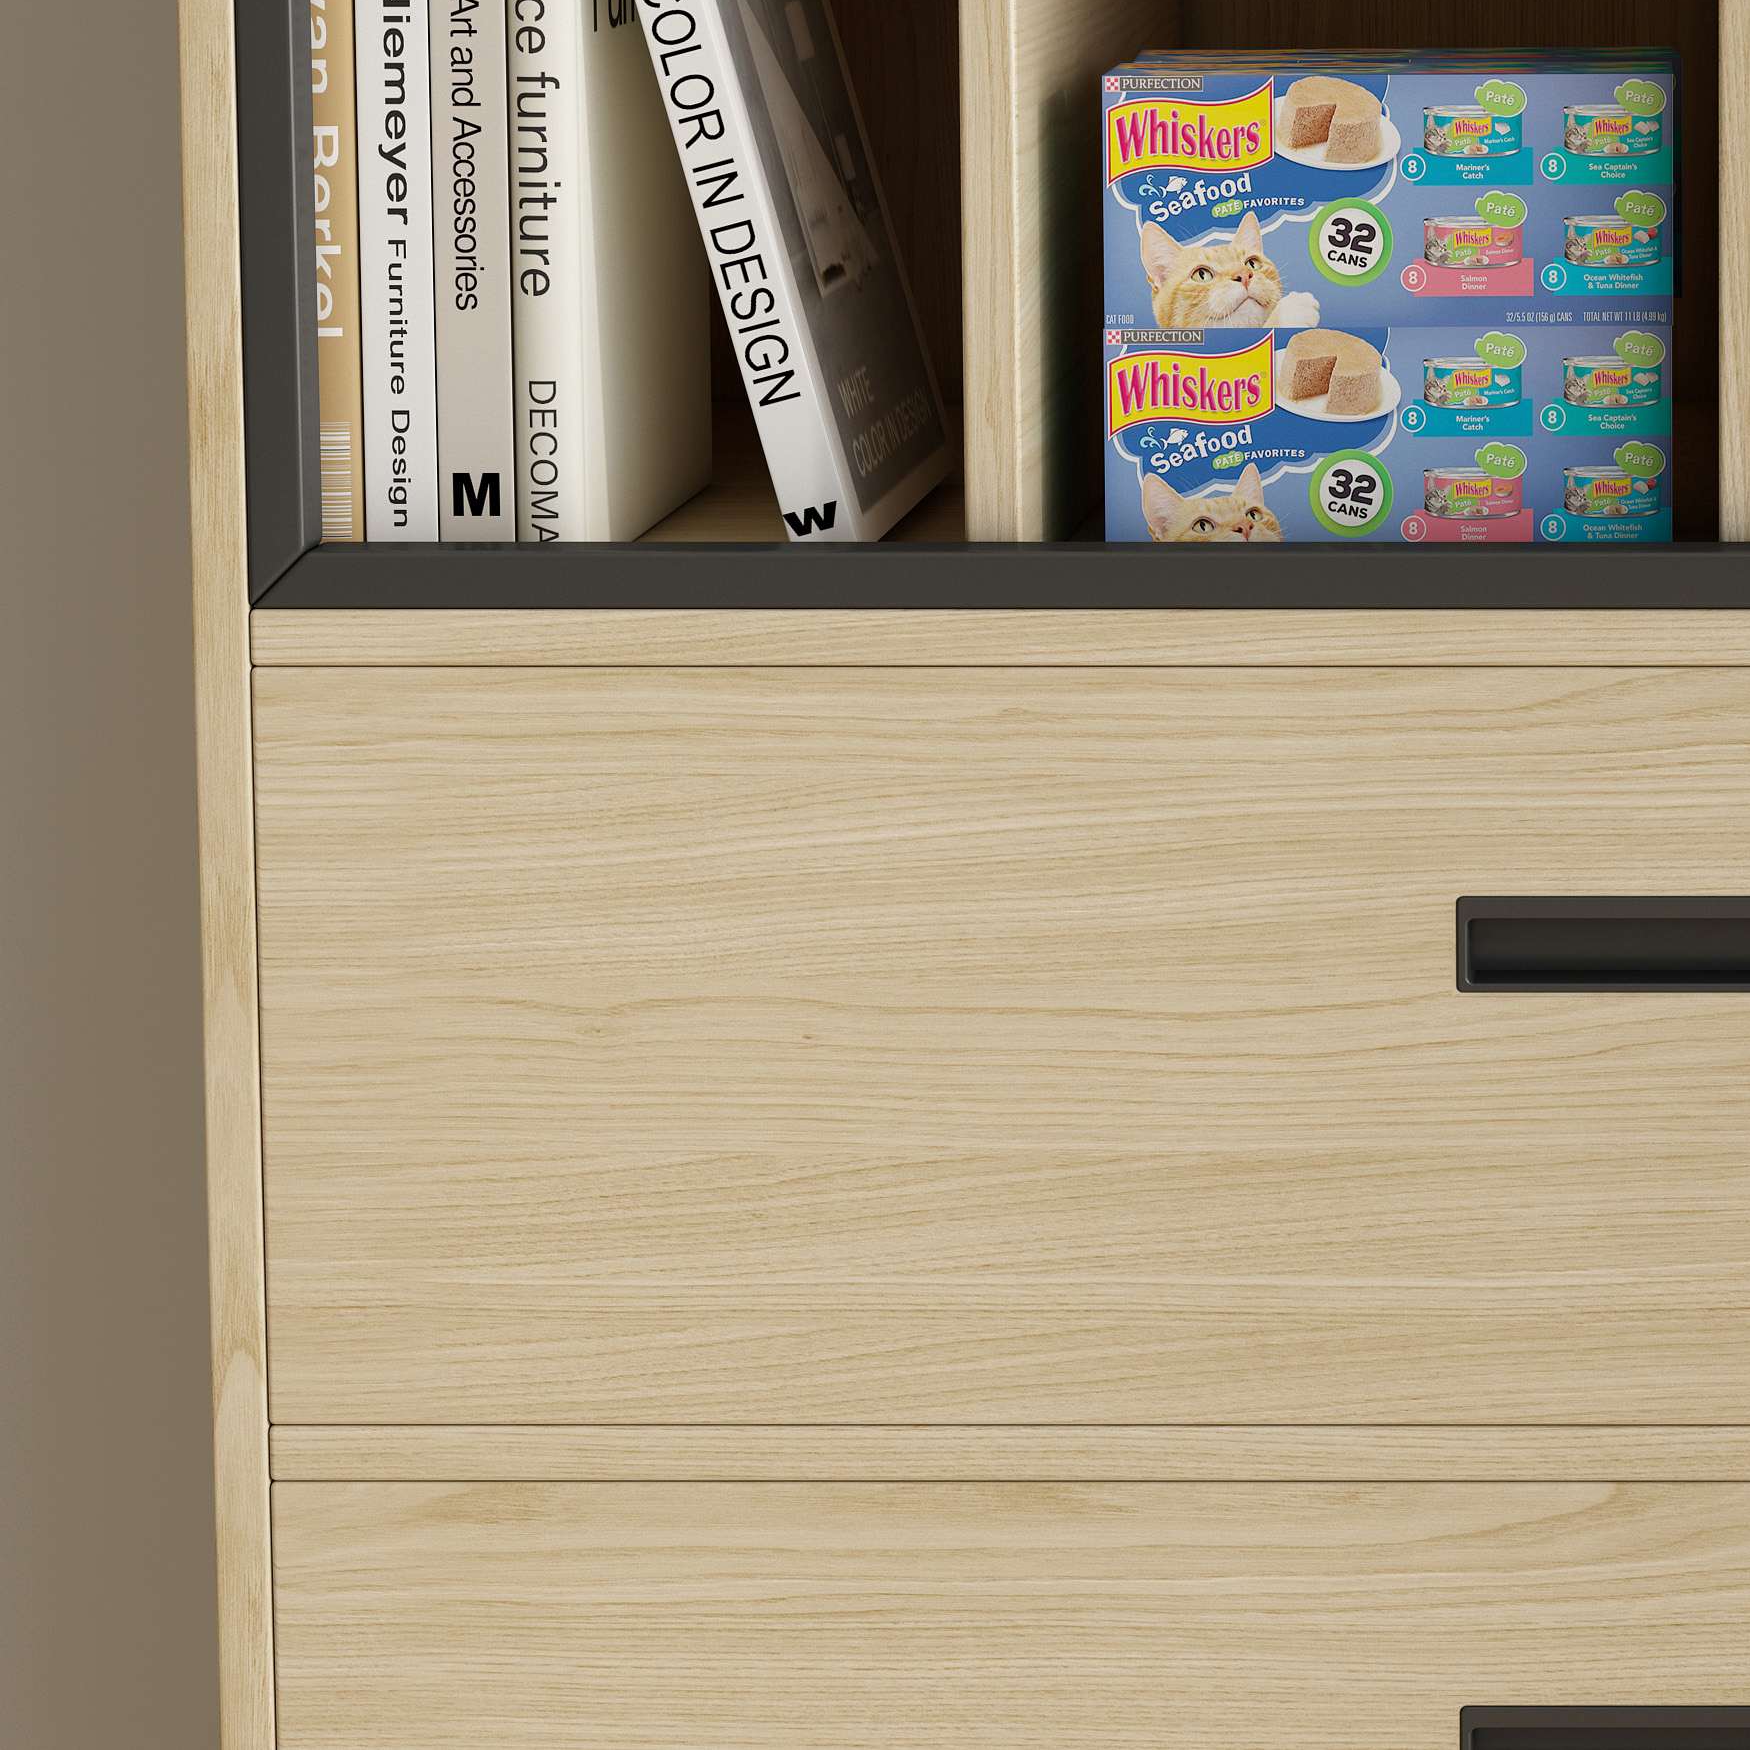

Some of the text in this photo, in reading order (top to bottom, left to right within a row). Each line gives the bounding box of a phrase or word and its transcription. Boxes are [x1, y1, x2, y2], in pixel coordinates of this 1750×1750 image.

[450, 46, 482, 107] and
[1122, 77, 1201, 90] PURFECTION
[1455, 118, 1489, 135] Whiskers
[1595, 118, 1629, 135] Whiskers
[1116, 109, 1261, 163] Whiskers
[1408, 160, 1417, 172] 8
[1455, 163, 1490, 172] Mariner's
[1549, 159, 1557, 172] 8
[1589, 163, 1637, 172] Sea Captain's
[1462, 172, 1484, 180] Catch
[1600, 171, 1625, 179] Choice
[516, 71, 562, 297] furniture
[692, 158, 744, 209] IN
[1149, 173, 1252, 222] Seafood
[1243, 197, 1305, 209] FAVORITES
[452, 117, 485, 311] Accessories
[1327, 218, 1376, 254] 32
[1455, 230, 1489, 246] Whiskers
[1595, 229, 1629, 246] Whiskers
[1327, 250, 1368, 268] CANS
[1409, 271, 1417, 283] 8
[1460, 274, 1487, 282] Salmon
[1549, 271, 1557, 283] 8
[1608, 273, 1643, 282] Whitefish
[1462, 282, 1486, 290] Dinner
[1614, 282, 1639, 290] Dinner
[387, 239, 409, 395] Furniture
[710, 219, 801, 407] DESIGN
[1106, 315, 1134, 324] CAT FOOD
[1556, 312, 1573, 322] CANS
[1584, 312, 1600, 322] TOTAL
[1602, 312, 1613, 321] NET
[1614, 312, 1623, 321] WT
[1123, 331, 1202, 343] PURFECTION
[1455, 370, 1489, 388] Whiskers
[1594, 369, 1629, 387] Whiskers
[1117, 361, 1262, 416] Whiskers
[1408, 412, 1417, 424] 8
[1455, 414, 1490, 423] Mariner's
[1548, 411, 1557, 424] 8
[1588, 414, 1637, 423] Sea Captain's
[1462, 423, 1484, 431] Catch
[1600, 422, 1625, 430] Choice
[1150, 425, 1253, 474] Seafood
[1244, 449, 1305, 461] FAVORITES
[528, 381, 559, 542] DECOMA
[388, 410, 411, 528] Design
[1328, 469, 1377, 505] 32
[1455, 481, 1489, 497] Whiskers
[1594, 480, 1629, 497] Whiskers
[452, 472, 501, 517] M
[1327, 501, 1369, 519] CANS
[783, 500, 837, 536] W
[1409, 522, 1418, 534] 8
[1460, 525, 1487, 533] Salmon
[1548, 521, 1557, 533] 8
[1583, 524, 1643, 532] Ocean Whitefish
